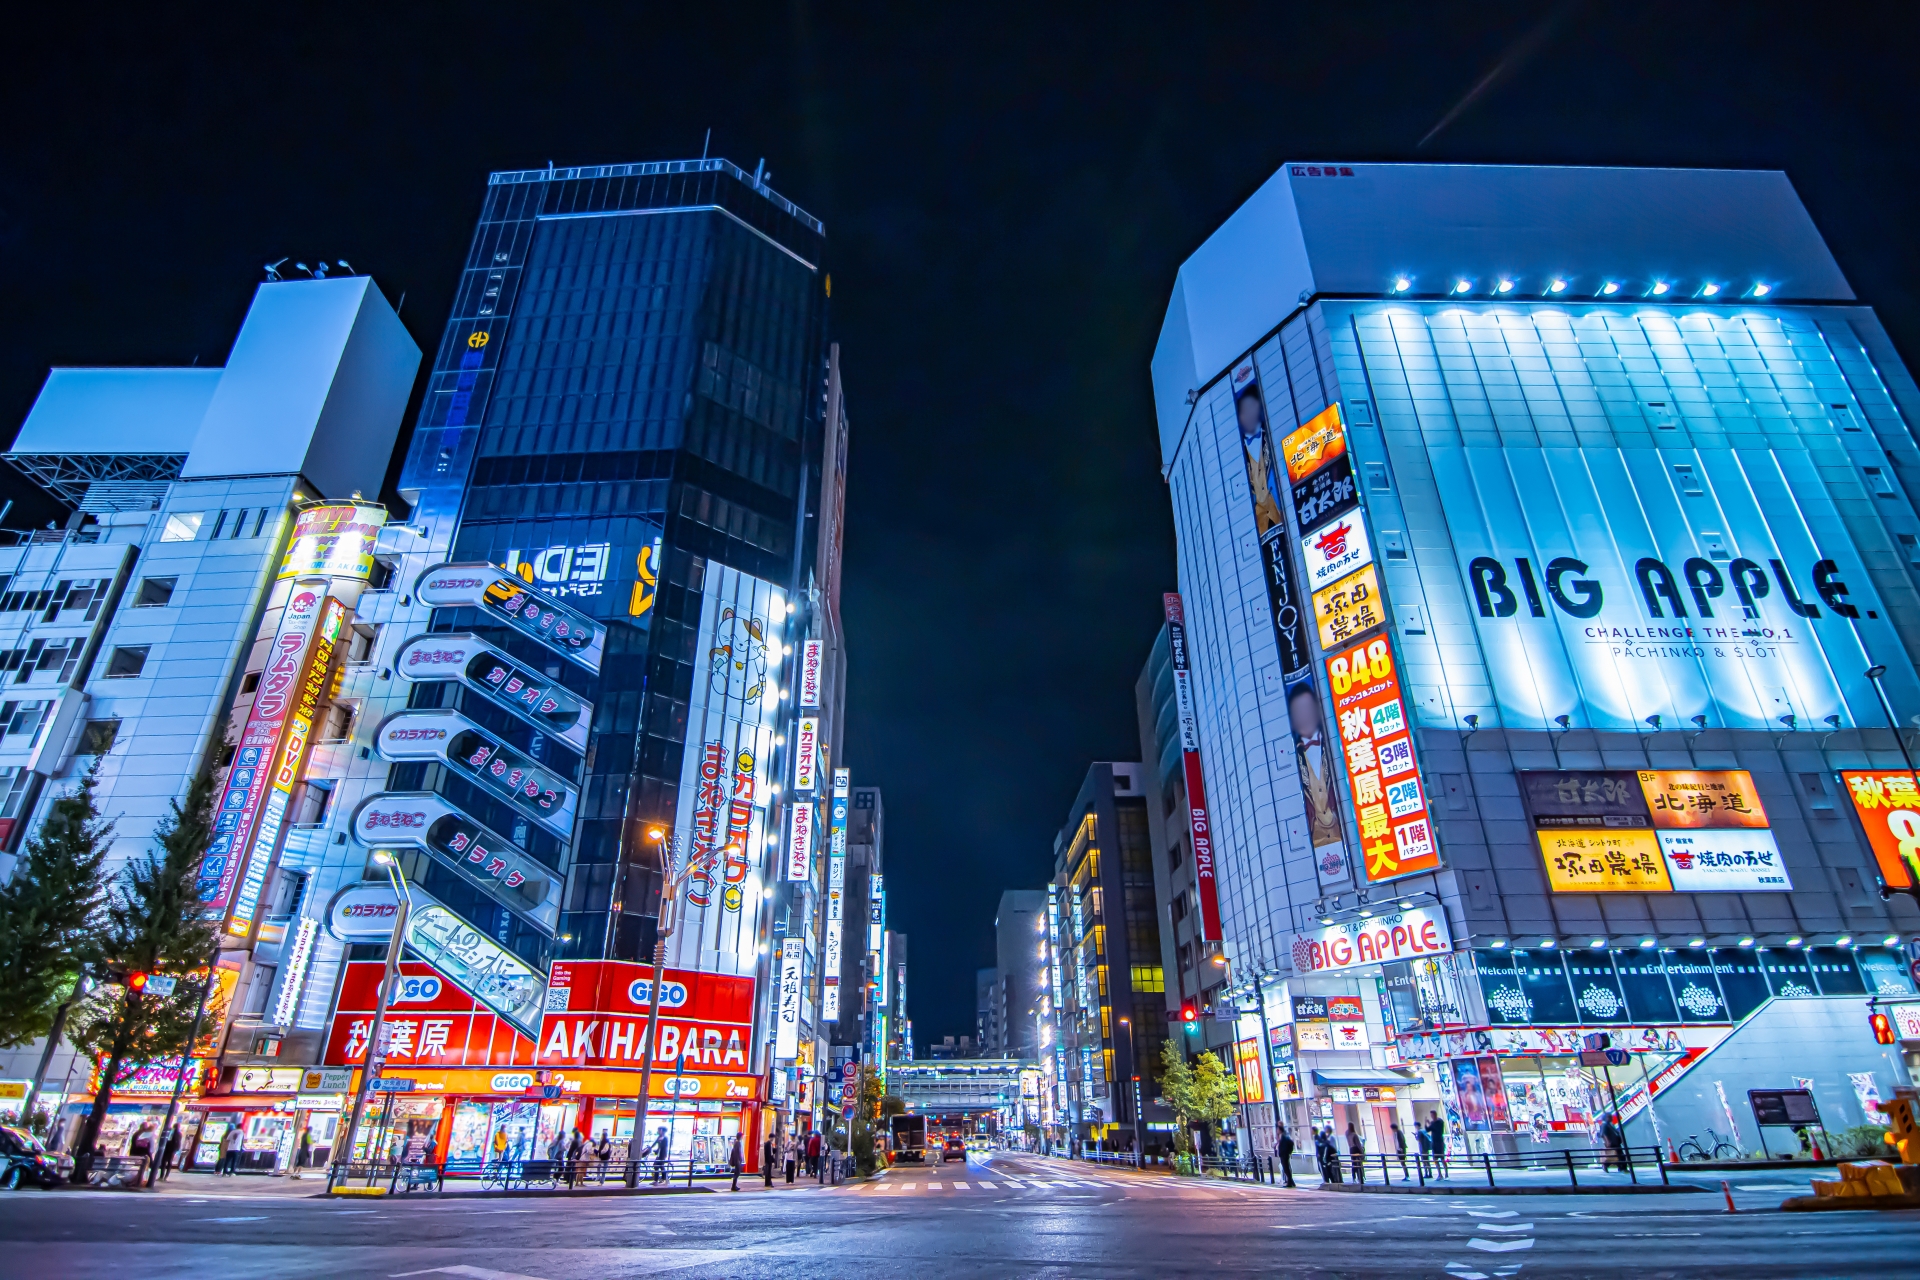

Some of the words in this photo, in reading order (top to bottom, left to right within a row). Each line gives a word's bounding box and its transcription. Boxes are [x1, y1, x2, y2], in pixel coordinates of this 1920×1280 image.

[1291, 167, 1355, 177] 広告募集
[1295, 486, 1307, 499] 7F
[1298, 476, 1354, 525] 甘太郎
[315, 507, 358, 522] DVD
[1304, 537, 1313, 547] 6F
[1316, 548, 1361, 579] 焼肉の万世
[435, 579, 477, 589] カラオケ
[1468, 556, 1604, 619] BIG
[504, 593, 587, 646] まねきねこ
[1584, 627, 1695, 639] CHALLENGE
[1704, 627, 1740, 638] THE
[316, 649, 329, 662] CD
[319, 638, 334, 653] ゲーム
[1613, 647, 1706, 658] PACHINKO
[1715, 647, 1726, 657] &
[1735, 647, 1778, 658] SLOT
[408, 650, 465, 665] まねきねこ
[1329, 638, 1392, 696] 848
[257, 632, 306, 718] ラムタラ
[308, 669, 325, 685] アニメ
[806, 642, 821, 705] まねきねこ
[487, 666, 558, 713] カラオケ
[1373, 702, 1401, 725] 4階
[396, 729, 440, 740] カラオケ
[1378, 721, 1401, 735] スロット
[276, 734, 303, 786] DVD
[800, 730, 814, 777] カラオケ
[1380, 741, 1409, 765] 3階
[469, 746, 558, 808] まねきねこ
[1386, 761, 1410, 774] スロット
[1640, 773, 1656, 782] 8F
[1339, 705, 1398, 877] 秋葉原最大
[1388, 781, 1419, 805] 2階
[1553, 777, 1631, 805] 甘太郎
[1394, 801, 1419, 815] スロット
[1654, 792, 1752, 814] 北海道
[365, 811, 427, 829] まねきねこ
[686, 740, 730, 908] まねきねこ
[722, 772, 758, 884] カラオケ
[1192, 807, 1207, 833] BIG
[793, 806, 808, 878] まねきねこ
[1397, 823, 1427, 847] 1階
[449, 832, 526, 888] カラオケ
[1195, 837, 1213, 878] APPLE
[1403, 843, 1430, 856] パチンコ
[1696, 850, 1774, 867] 焼肉の万世
[1553, 850, 1659, 878] 塚田農場
[1758, 876, 1785, 884] 秋葉原店
[352, 905, 397, 917] カラオケ
[414, 911, 482, 950] ゲームの
[295, 929, 309, 963] カラオケ
[1308, 937, 1353, 971] BIG
[1477, 966, 1528, 976] Welcome!
[1646, 964, 1735, 974] Entertainment
[631, 980, 685, 1005] GiGO
[782, 966, 799, 1023] 元祖寿司
[1296, 1003, 1325, 1015] 甘太郎
[1383, 1010, 1392, 1021] 2F
[344, 1018, 454, 1059] 秋葉原
[544, 1018, 745, 1067] AKIHABARA
[1608, 1051, 1620, 1062] 17
[322, 1081, 347, 1089] Lunch
[324, 1073, 349, 1081] Pepper
[494, 1075, 532, 1088] GiGO
